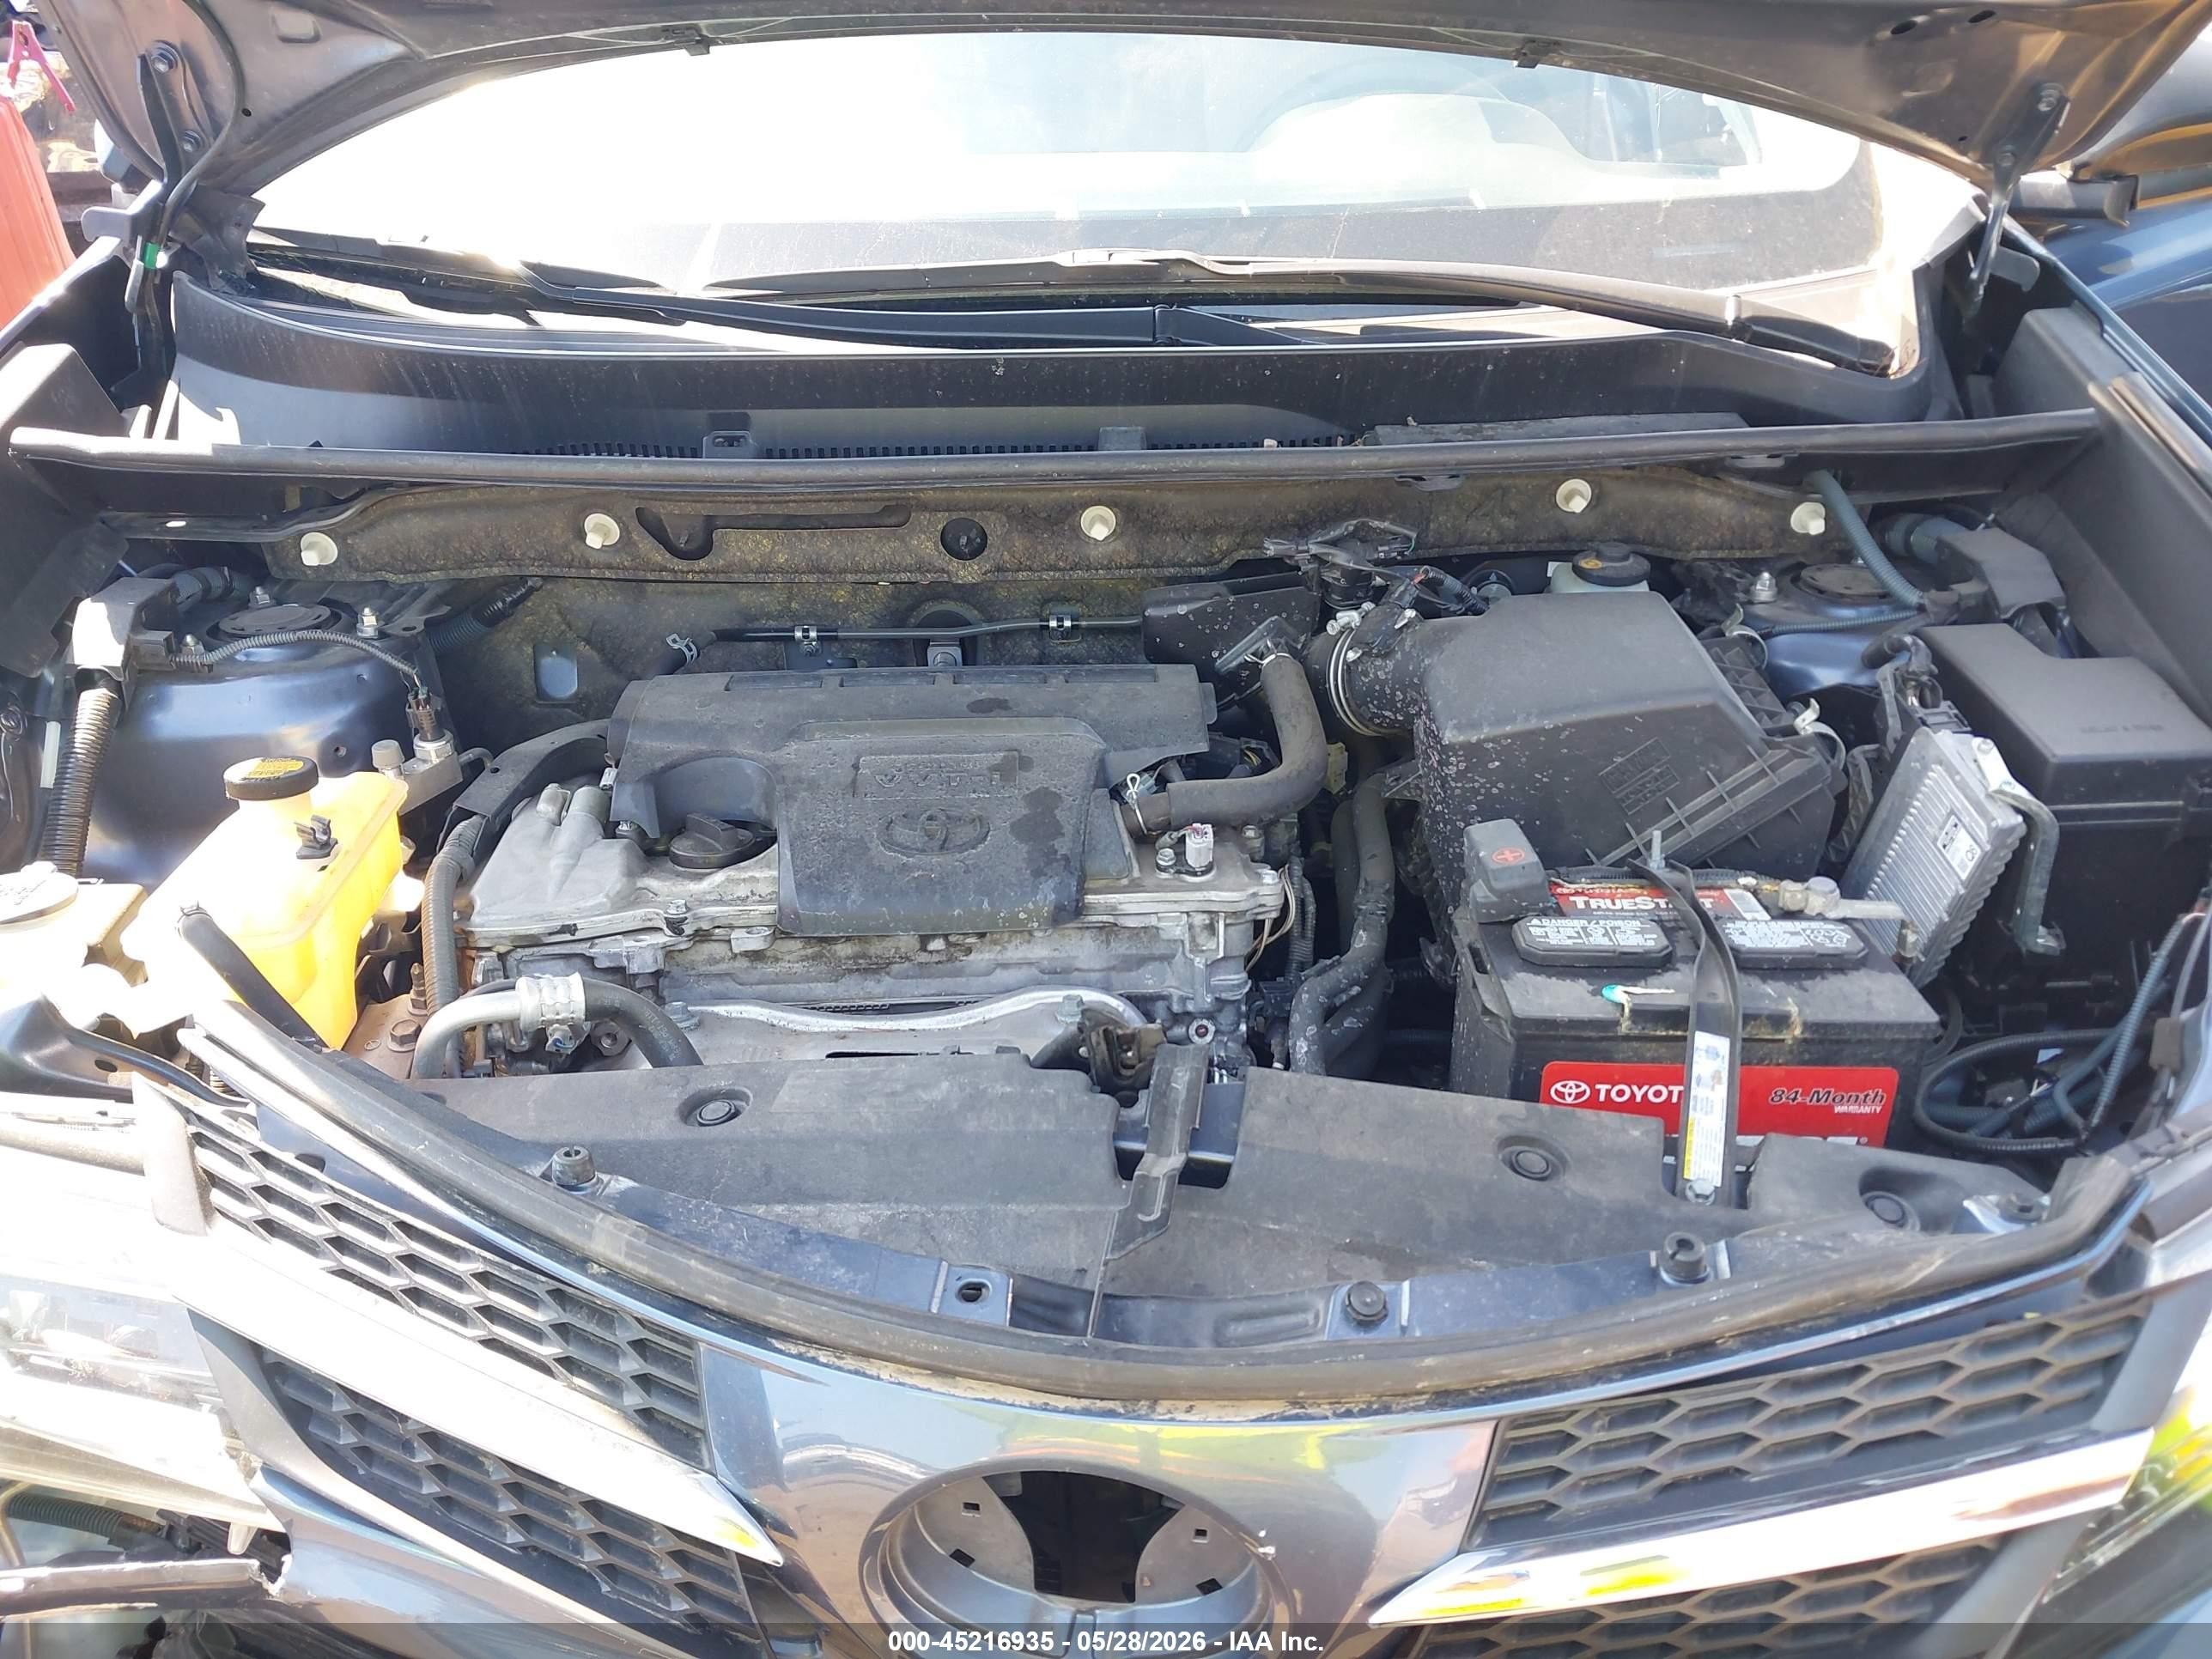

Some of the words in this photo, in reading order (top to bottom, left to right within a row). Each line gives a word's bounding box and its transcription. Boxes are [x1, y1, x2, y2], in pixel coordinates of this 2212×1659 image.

[1542, 918, 1587, 927] DANGER
[1598, 920, 1641, 928] POISON
[1595, 1084, 1684, 1103] TOYOT
[1769, 1088, 1887, 1105] 84-Month
[1833, 1105, 1883, 1114] WARRANTY
